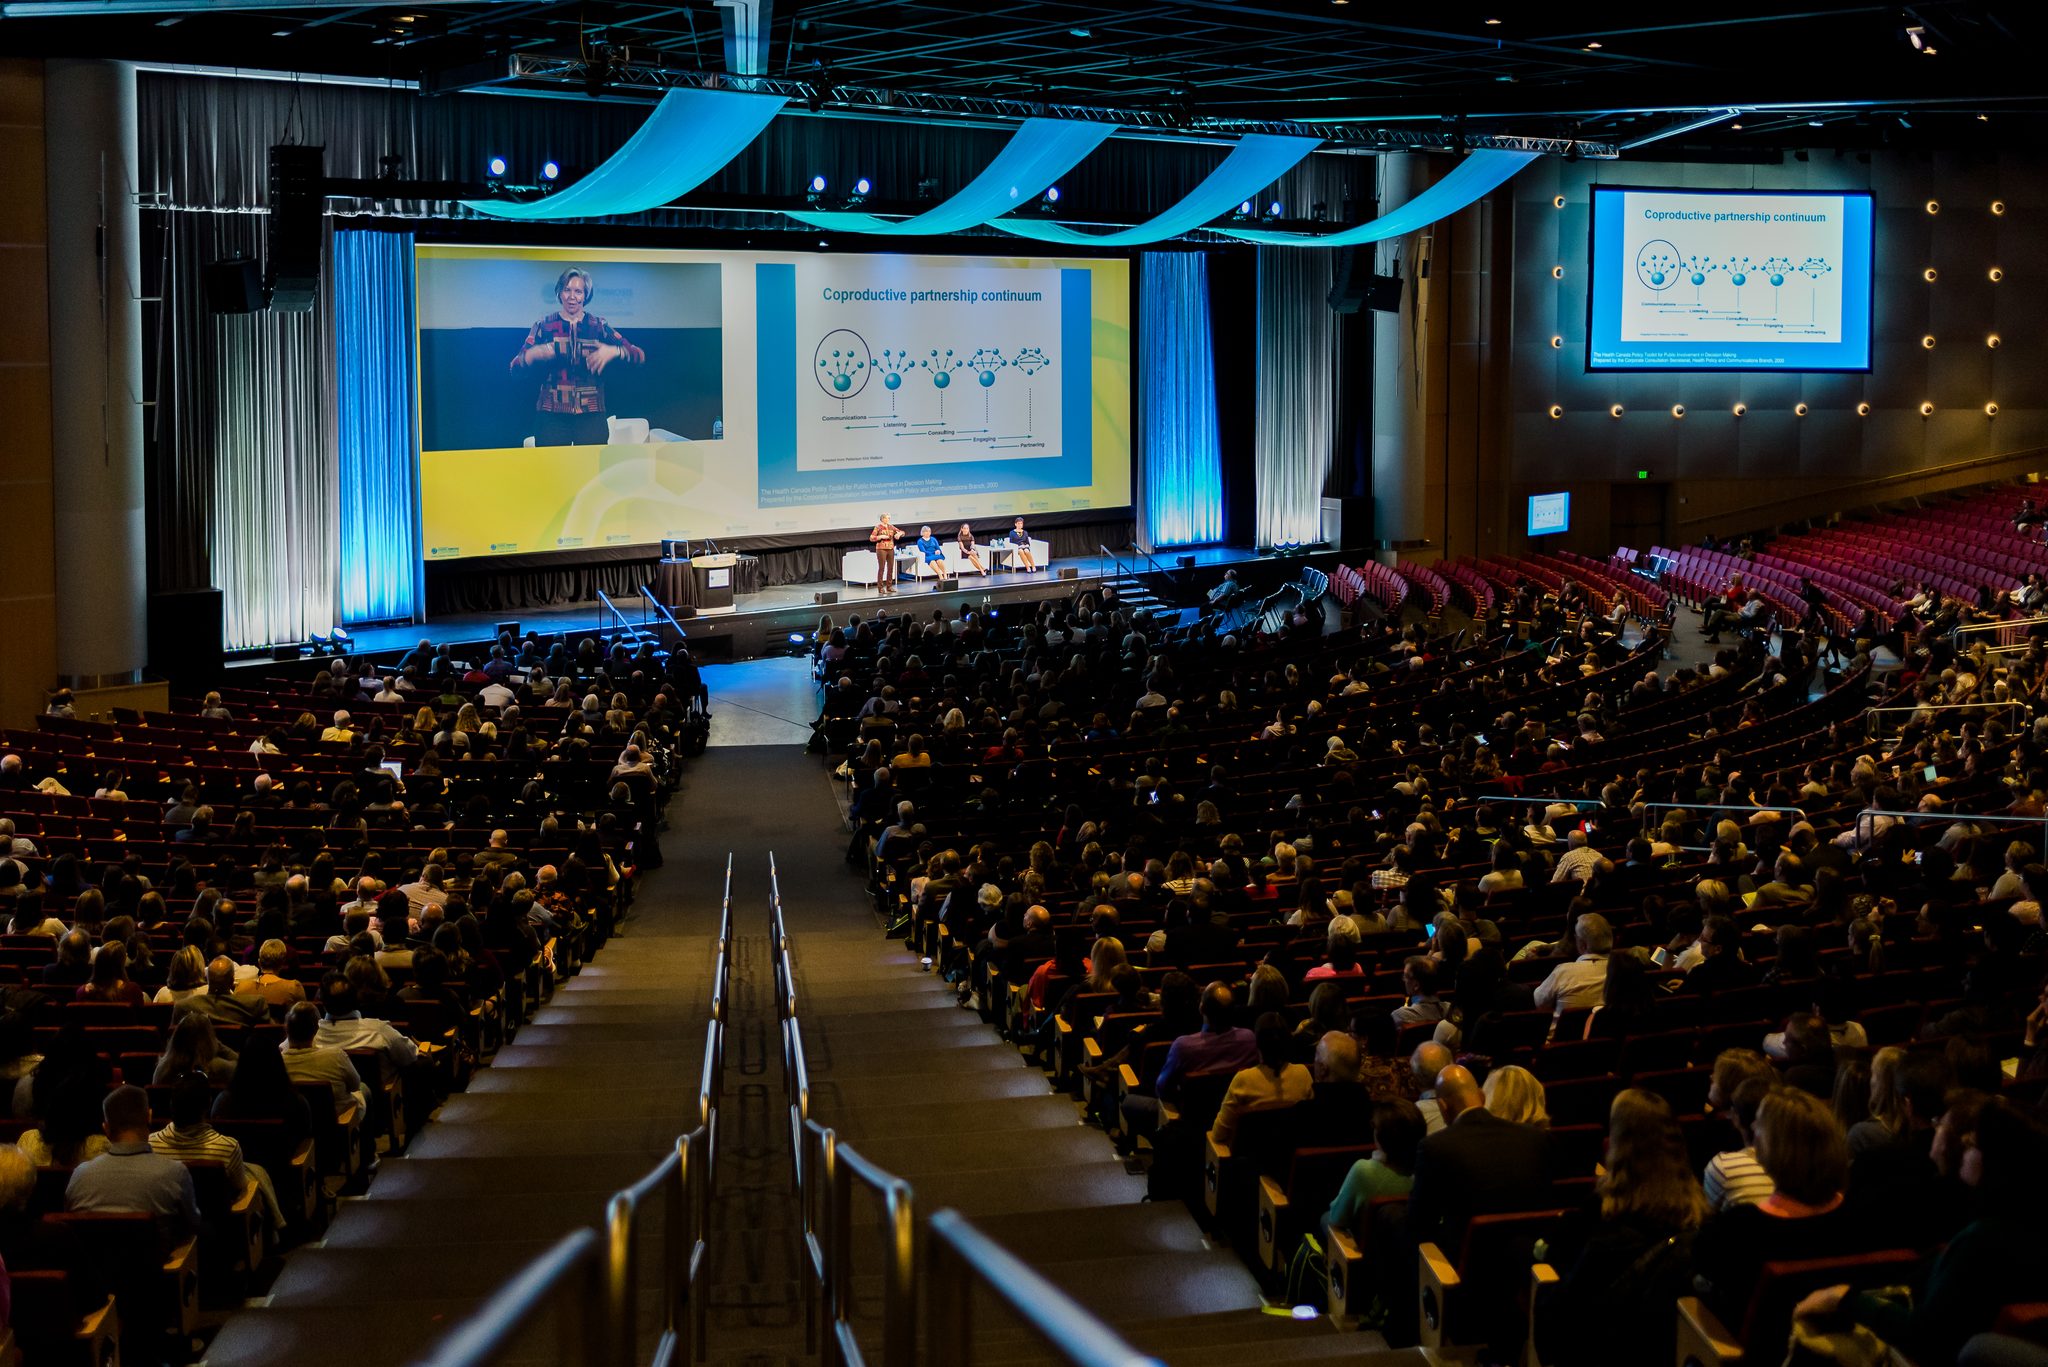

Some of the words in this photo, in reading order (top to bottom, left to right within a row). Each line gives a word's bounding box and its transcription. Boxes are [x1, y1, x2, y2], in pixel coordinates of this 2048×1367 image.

[1644, 209, 1711, 222] Coproductive
[1714, 212, 1770, 224] partnership
[1773, 212, 1827, 223] continuum
[823, 287, 906, 304] Coproductive
[910, 288, 978, 304] partnership
[981, 290, 1042, 302] continuum
[821, 414, 867, 422] Communications
